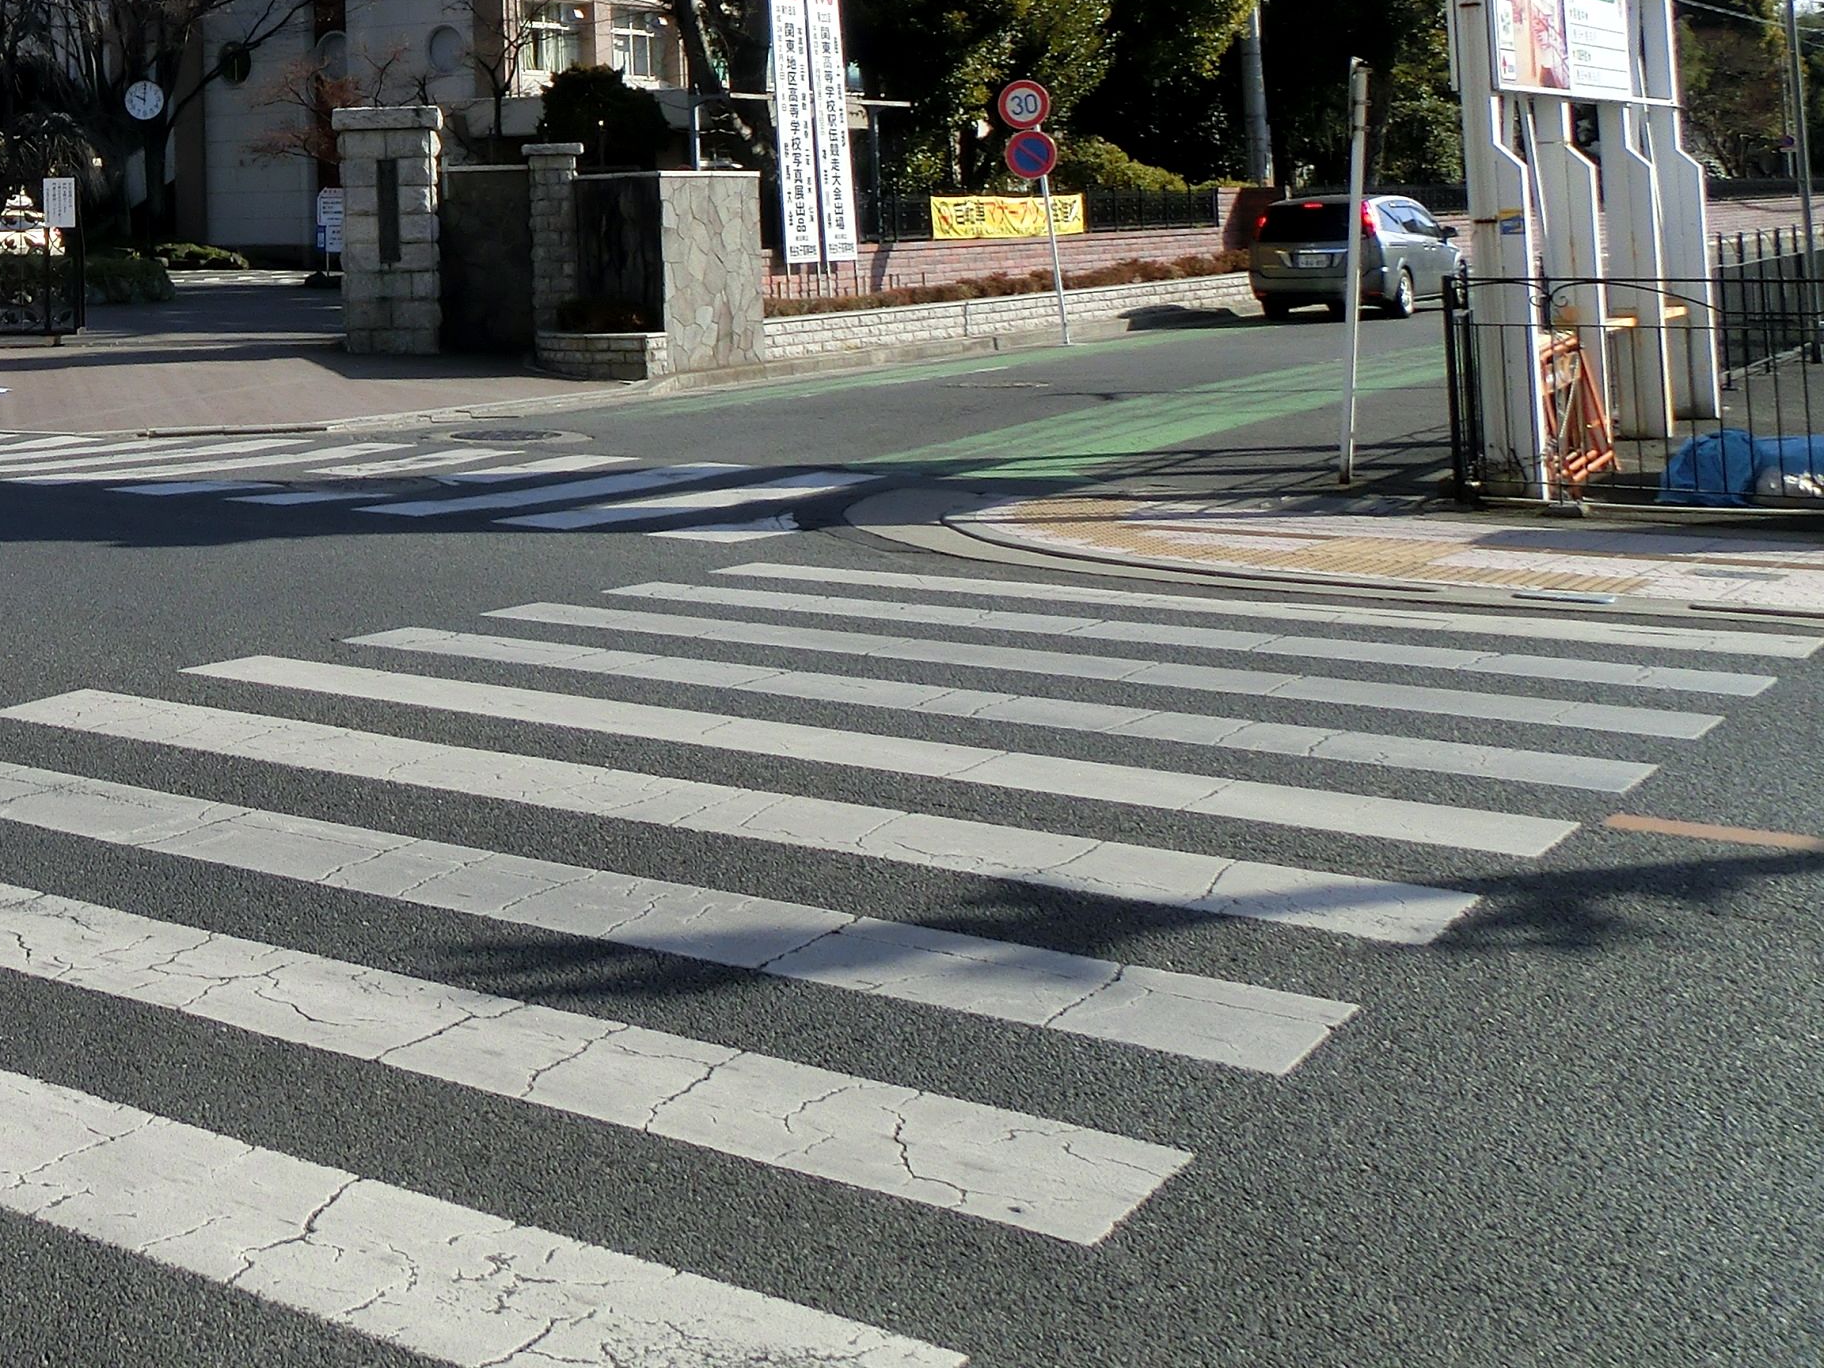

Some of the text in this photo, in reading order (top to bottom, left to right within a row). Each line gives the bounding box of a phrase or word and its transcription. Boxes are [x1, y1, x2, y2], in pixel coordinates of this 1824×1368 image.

[784, 22, 807, 233] 関東地区高等学校写真展出品
[820, 26, 845, 230] 関東高等学校駅伝競走大会出場
[1011, 94, 1037, 115] 30
